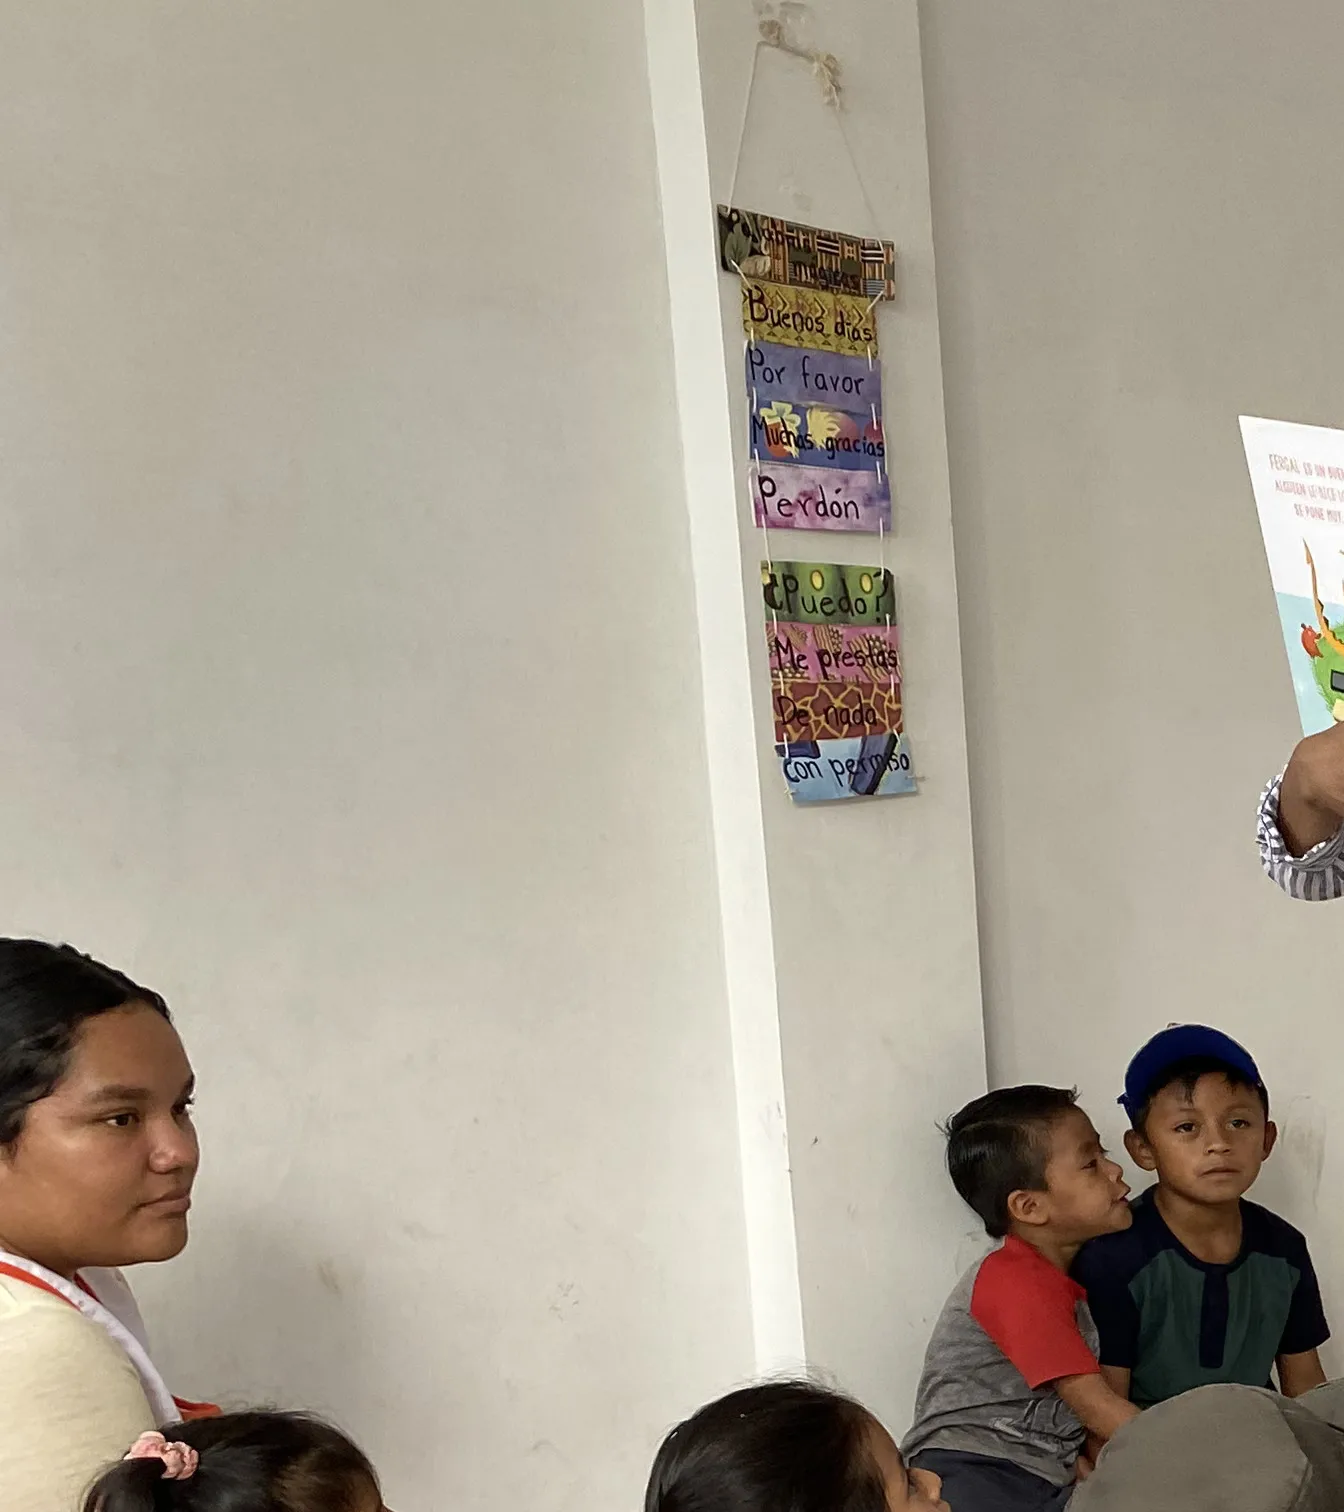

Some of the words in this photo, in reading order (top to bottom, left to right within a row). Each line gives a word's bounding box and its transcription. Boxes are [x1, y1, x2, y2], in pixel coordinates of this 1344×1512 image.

[749, 284, 825, 335] Buenos
[748, 347, 786, 385] Por
[802, 355, 864, 395] favor
[752, 415, 814, 450] Muchas
[825, 435, 885, 459] gracias
[758, 474, 859, 521] Perdón
[762, 567, 893, 623] ¿Puedo?
[774, 636, 809, 671] Me
[818, 646, 898, 680] prestas
[777, 695, 809, 727] De
[823, 696, 877, 726] nada
[784, 757, 823, 783] con
[829, 751, 910, 787] permiso
